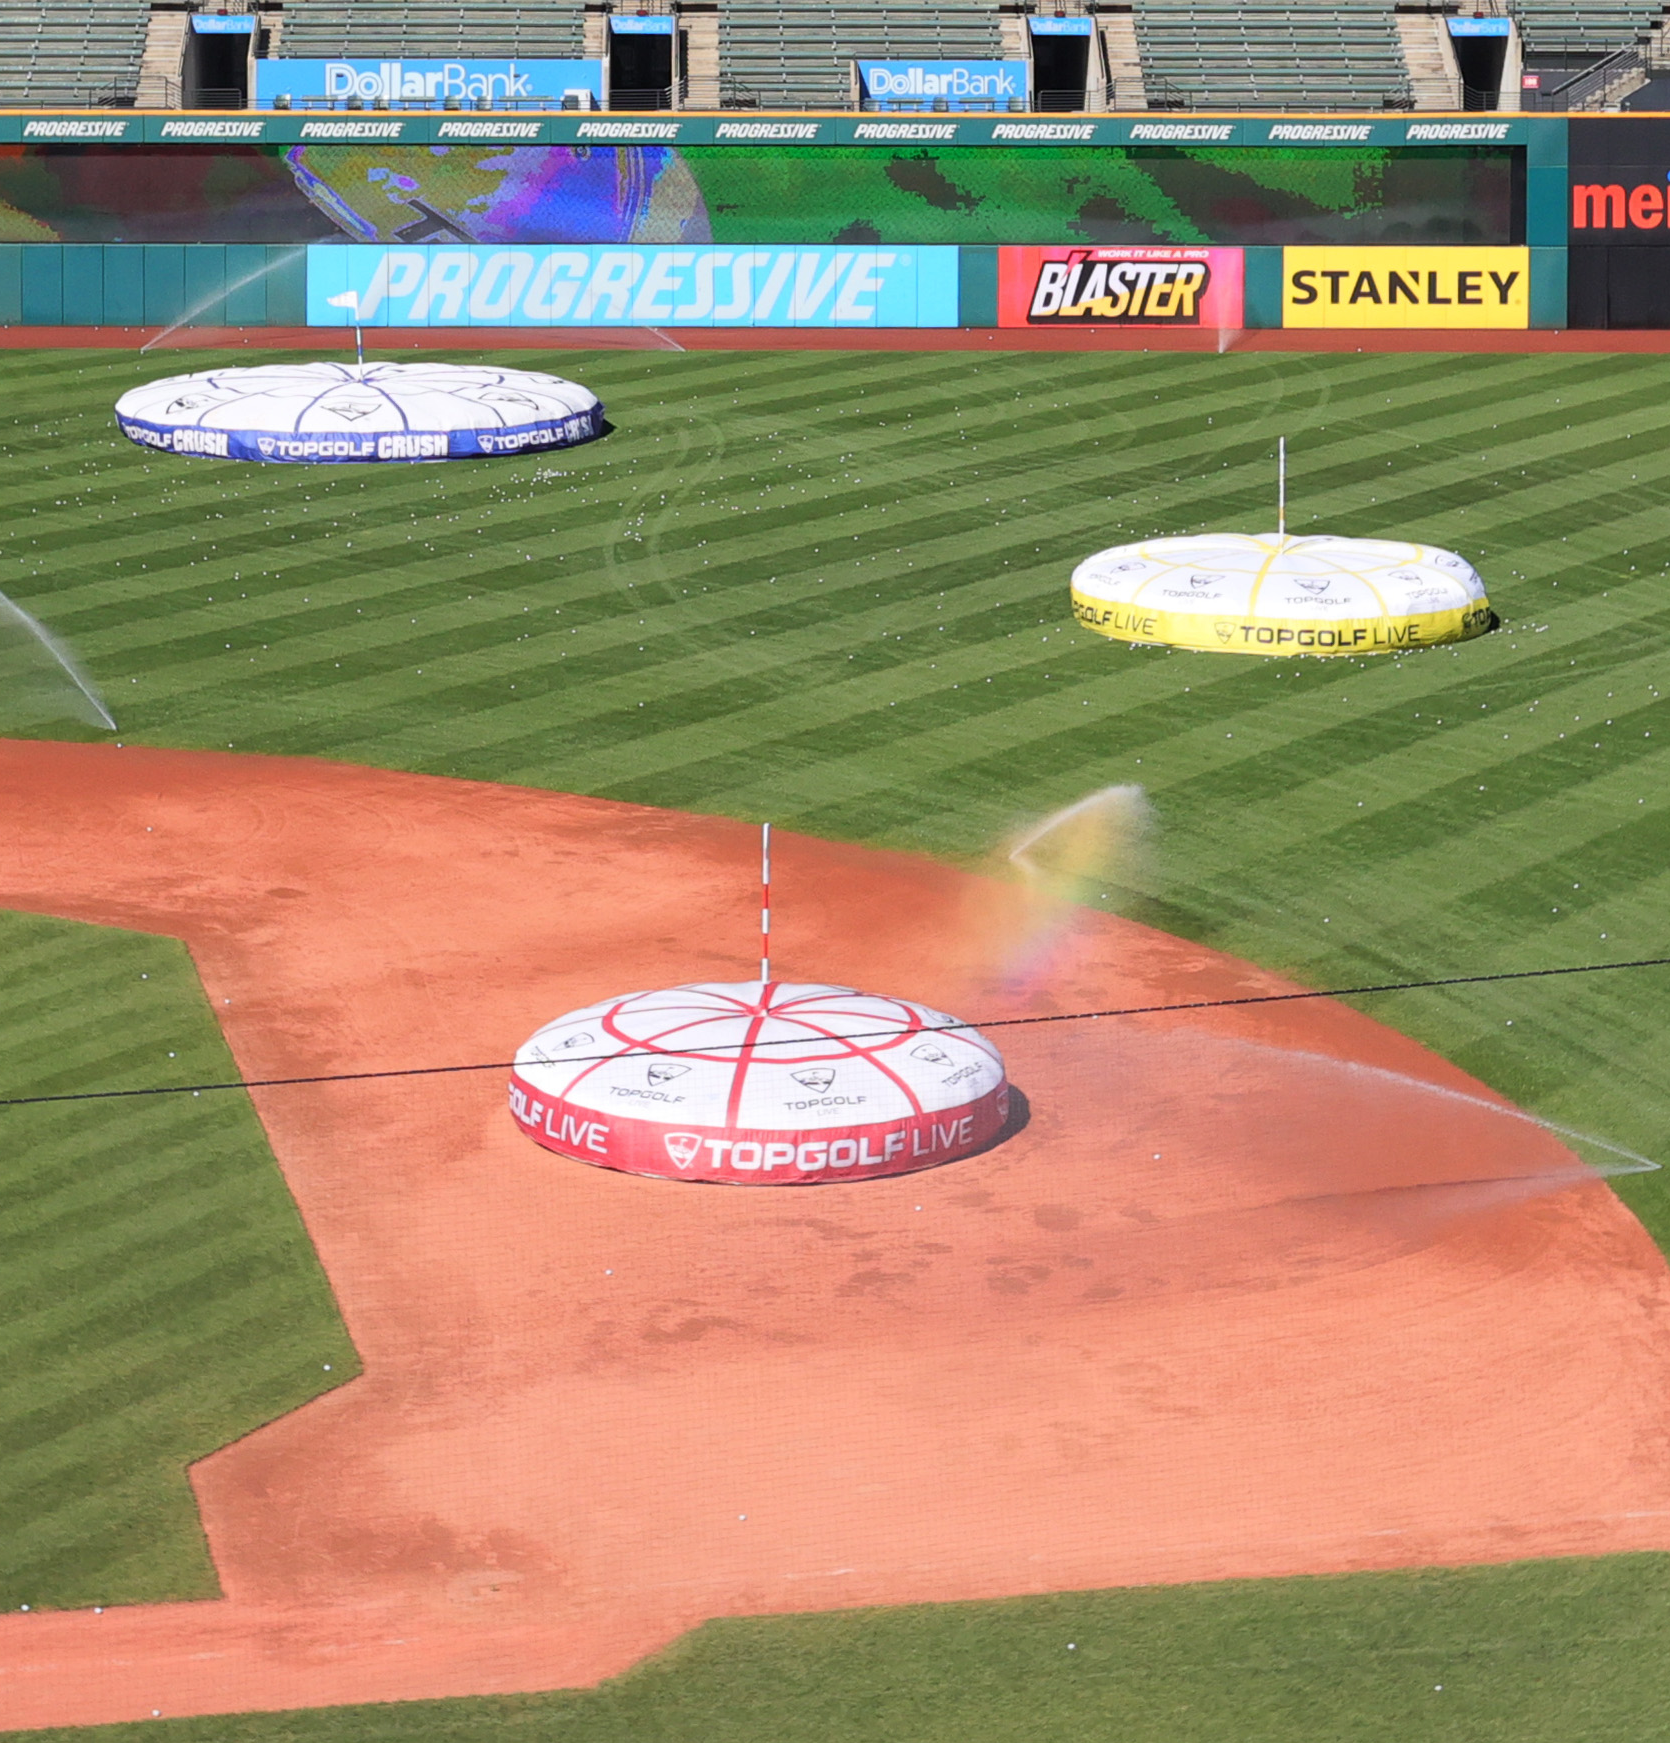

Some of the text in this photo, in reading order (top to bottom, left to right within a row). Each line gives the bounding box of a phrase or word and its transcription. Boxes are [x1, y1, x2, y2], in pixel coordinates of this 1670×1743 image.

[868, 65, 1017, 98] DollarBank
[23, 120, 127, 138] PROGRESSIVE
[159, 120, 264, 138] PROGRESSIVE
[299, 121, 403, 139] PROGRESSIVE
[436, 121, 541, 139] PROGRESSIVE
[575, 121, 680, 139] PROGRESSIVE
[715, 121, 818, 139] PROGRESSIVE
[853, 122, 958, 139] PROGRESSIVE
[991, 123, 1096, 140] PROGRESSIVE
[1129, 123, 1233, 140] PROGRESSIVE
[1267, 123, 1372, 140] PROGRESSIVE
[1405, 123, 1510, 140] PROGRESSIVE
[1097, 249, 1210, 258] WORK IT LIKE A PRO
[358, 251, 897, 322] PROGRESSIVE
[1291, 269, 1520, 306] STANLEY
[172, 429, 228, 457] CRUSH
[277, 434, 449, 458] TOPGOLF CRUSH
[494, 427, 565, 449] TOPGOLF
[1162, 588, 1224, 601] TOPGOLF
[1114, 612, 1158, 636] LIVE
[1240, 623, 1421, 646] TOPGOLF LIVE
[609, 1086, 687, 1105] TOPGOLF
[784, 1094, 868, 1111] TOPGOLF
[544, 1113, 610, 1155] LIVE
[703, 1114, 975, 1173] TOPGOLF LIVE
